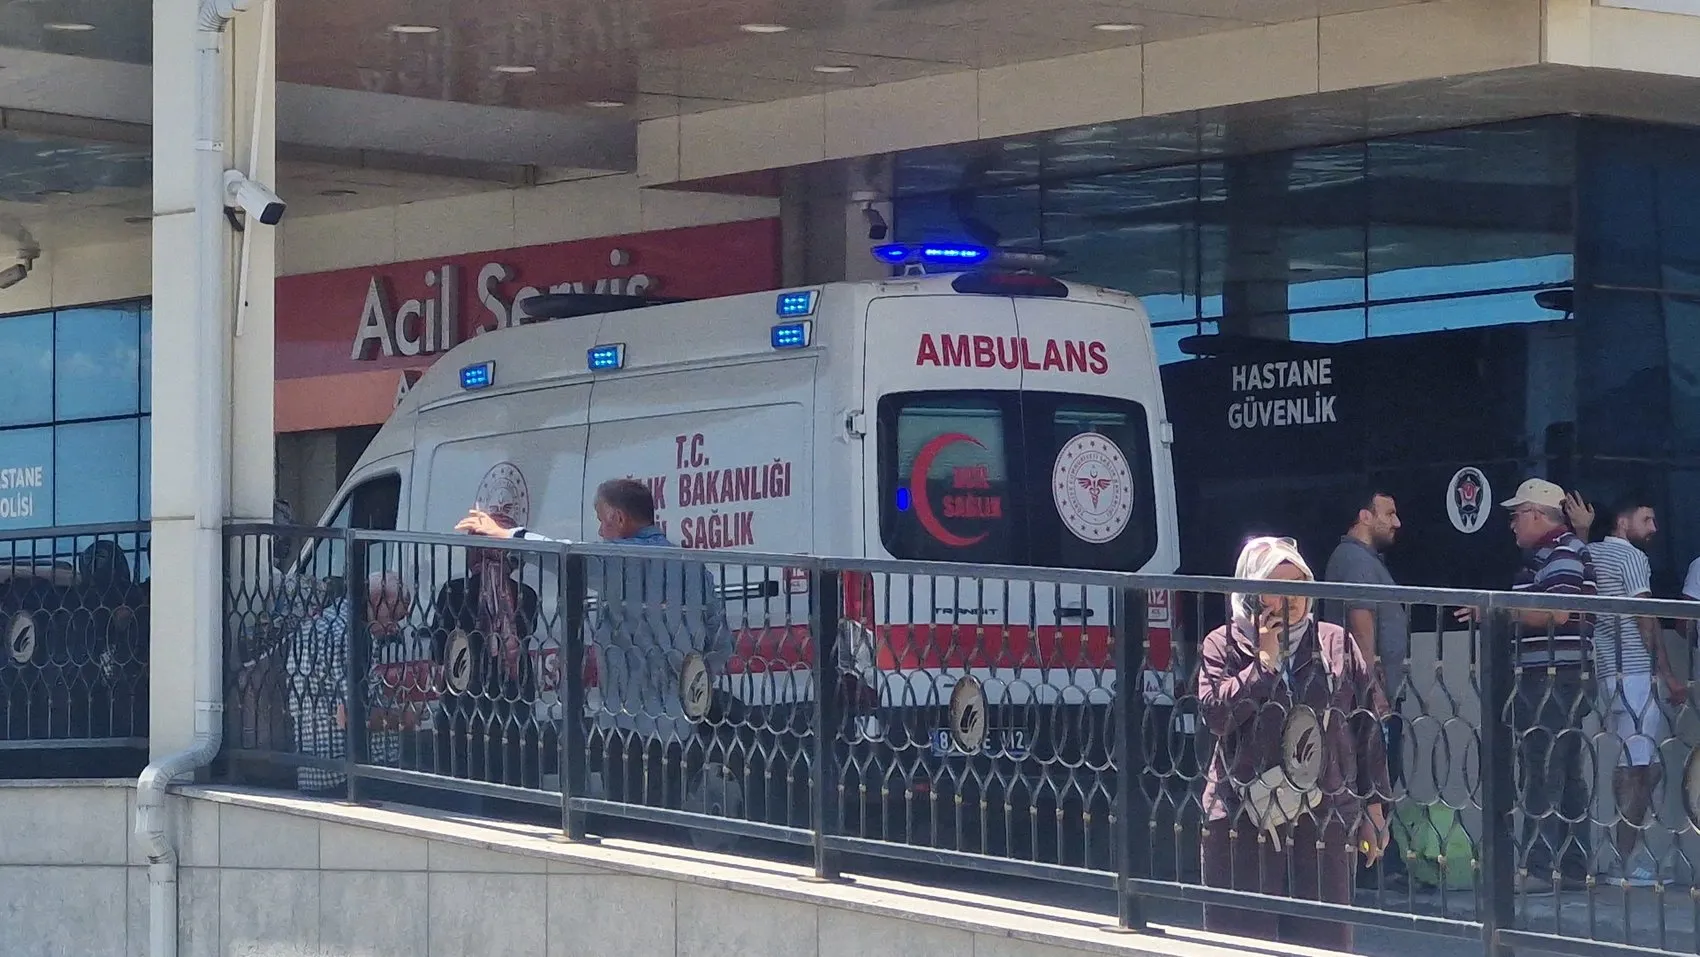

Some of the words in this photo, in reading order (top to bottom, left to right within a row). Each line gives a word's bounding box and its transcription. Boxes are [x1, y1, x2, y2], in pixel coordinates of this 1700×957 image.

[352, 265, 450, 360] Acil
[476, 249, 651, 335] Sei
[916, 333, 1109, 375] AMBULANS
[1232, 358, 1332, 391] HASTANE
[1228, 391, 1337, 429] GÜVENLİK
[676, 433, 709, 469] T.C.
[0, 466, 42, 489] STANE
[679, 457, 791, 507] BAKANLIĞI
[0, 492, 33, 518] OLİSİ
[681, 509, 754, 549] SAĞLIK
